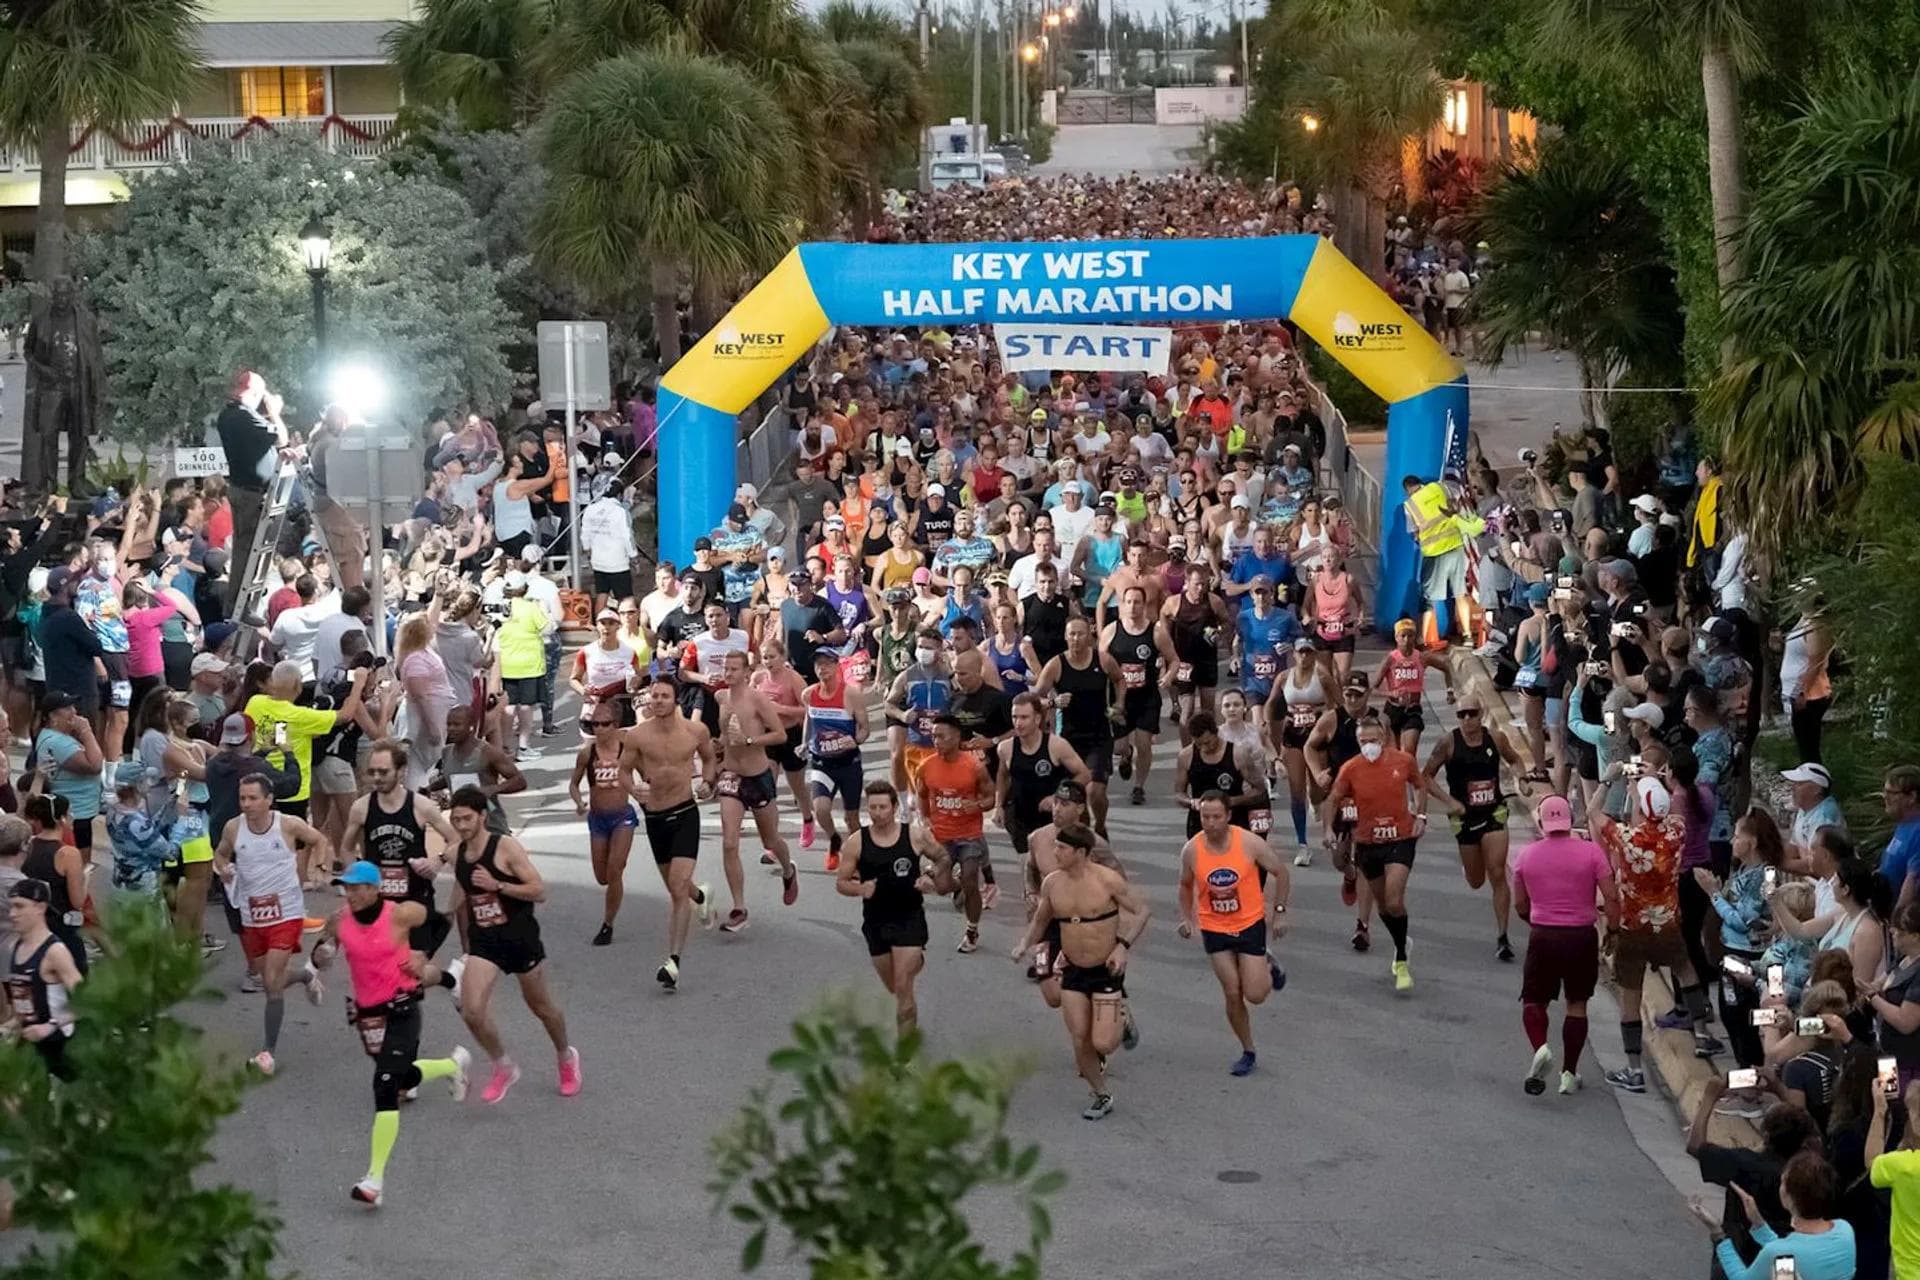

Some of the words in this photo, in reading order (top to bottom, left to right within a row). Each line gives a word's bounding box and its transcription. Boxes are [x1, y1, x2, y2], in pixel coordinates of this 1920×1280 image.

[952, 252, 1031, 281] KEY
[1043, 250, 1150, 279] WEST
[882, 288, 985, 316] HALF
[996, 284, 1232, 314] MARATHON
[1360, 324, 1403, 335] WEST
[740, 333, 785, 344] WEST
[1334, 335, 1365, 346] KEY
[714, 344, 744, 355] KEY
[1005, 335, 1161, 358] START
[193, 453, 216, 462] 100
[179, 463, 217, 471] GRINNELL
[251, 905, 281, 920] 2221
